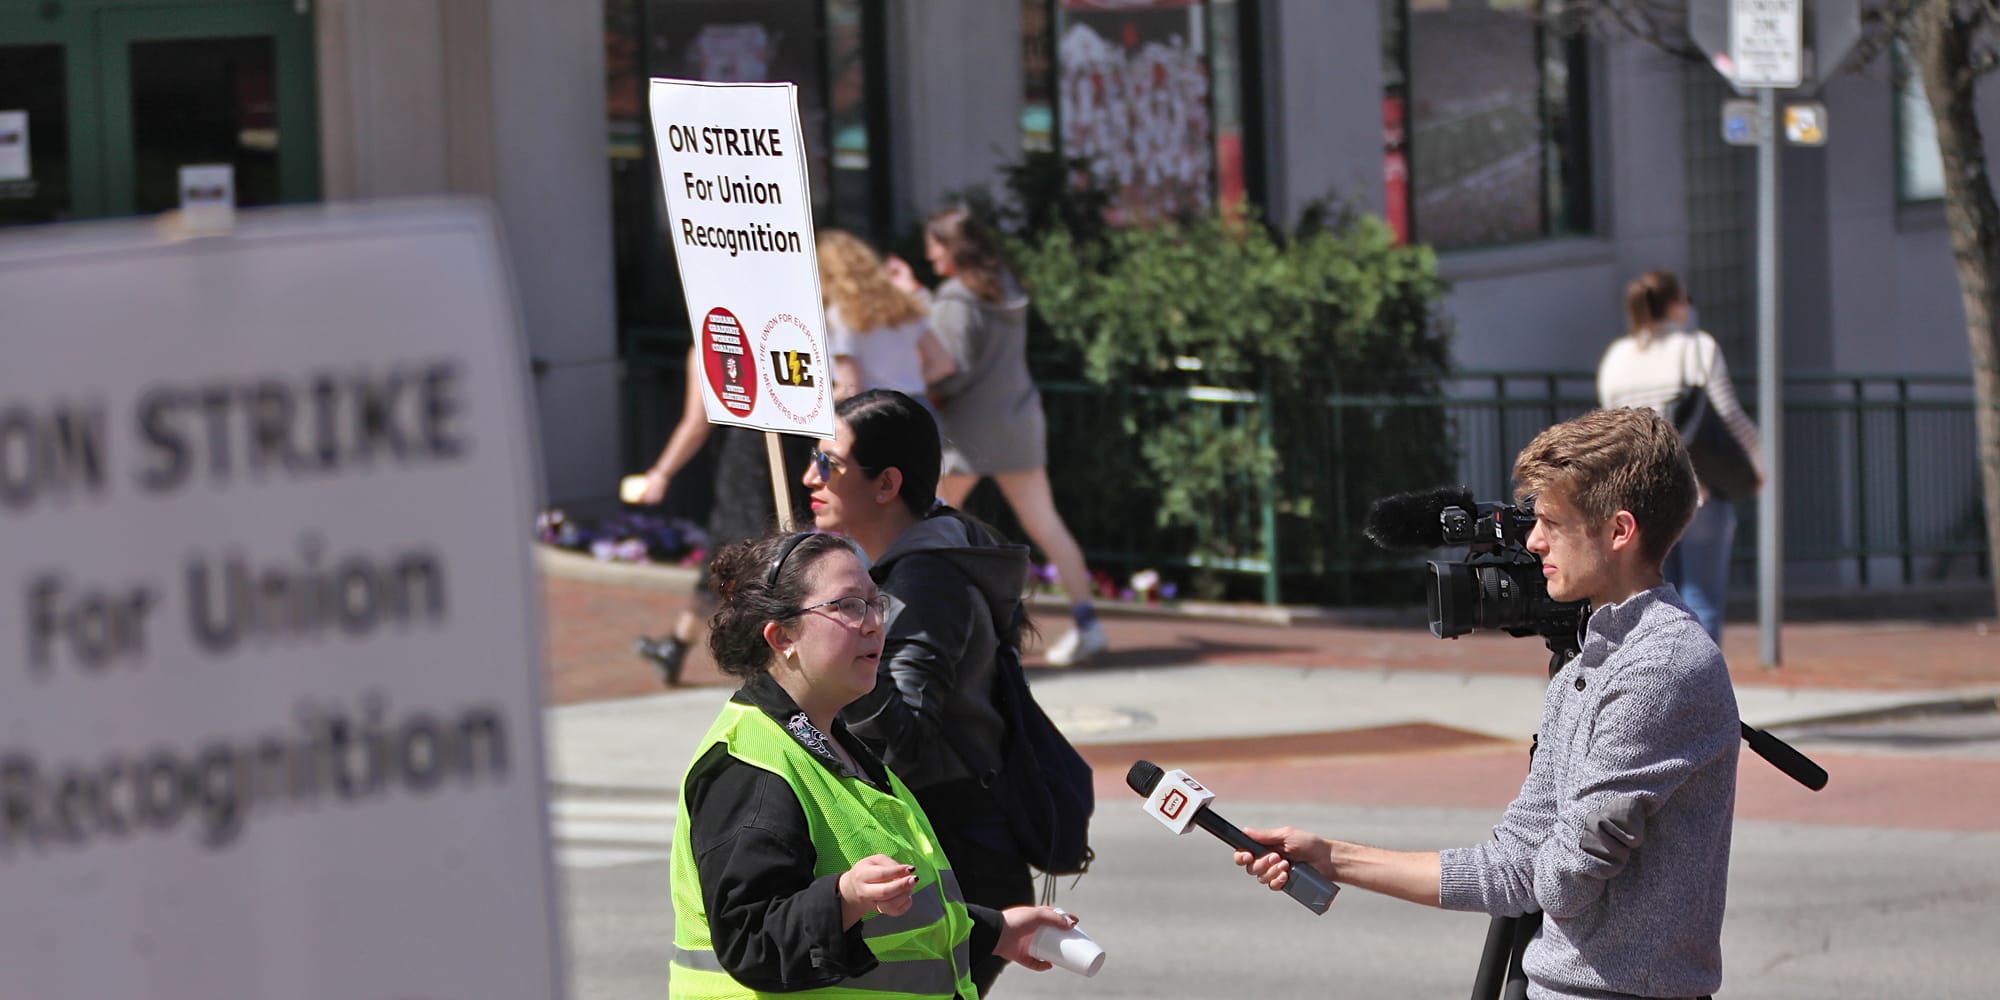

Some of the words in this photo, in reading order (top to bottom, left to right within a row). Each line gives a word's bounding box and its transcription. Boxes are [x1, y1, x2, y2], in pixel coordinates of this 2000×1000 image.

[669, 124, 699, 153] ON
[702, 126, 784, 156] STRIKE
[683, 172, 713, 201] For
[717, 175, 783, 205] Union
[681, 218, 802, 258] Recognition
[761, 316, 778, 341] UNION
[778, 313, 793, 323] FOR
[793, 317, 822, 366] EVERYONE
[770, 350, 815, 388] UE
[763, 373, 792, 420] MEMBERS
[793, 414, 807, 424] RUN
[806, 407, 819, 423] THIS
[816, 376, 824, 409] UNION
[0, 402, 108, 508] ON
[134, 358, 470, 493] STRIKE
[26, 569, 155, 678] For
[183, 530, 448, 656] Union
